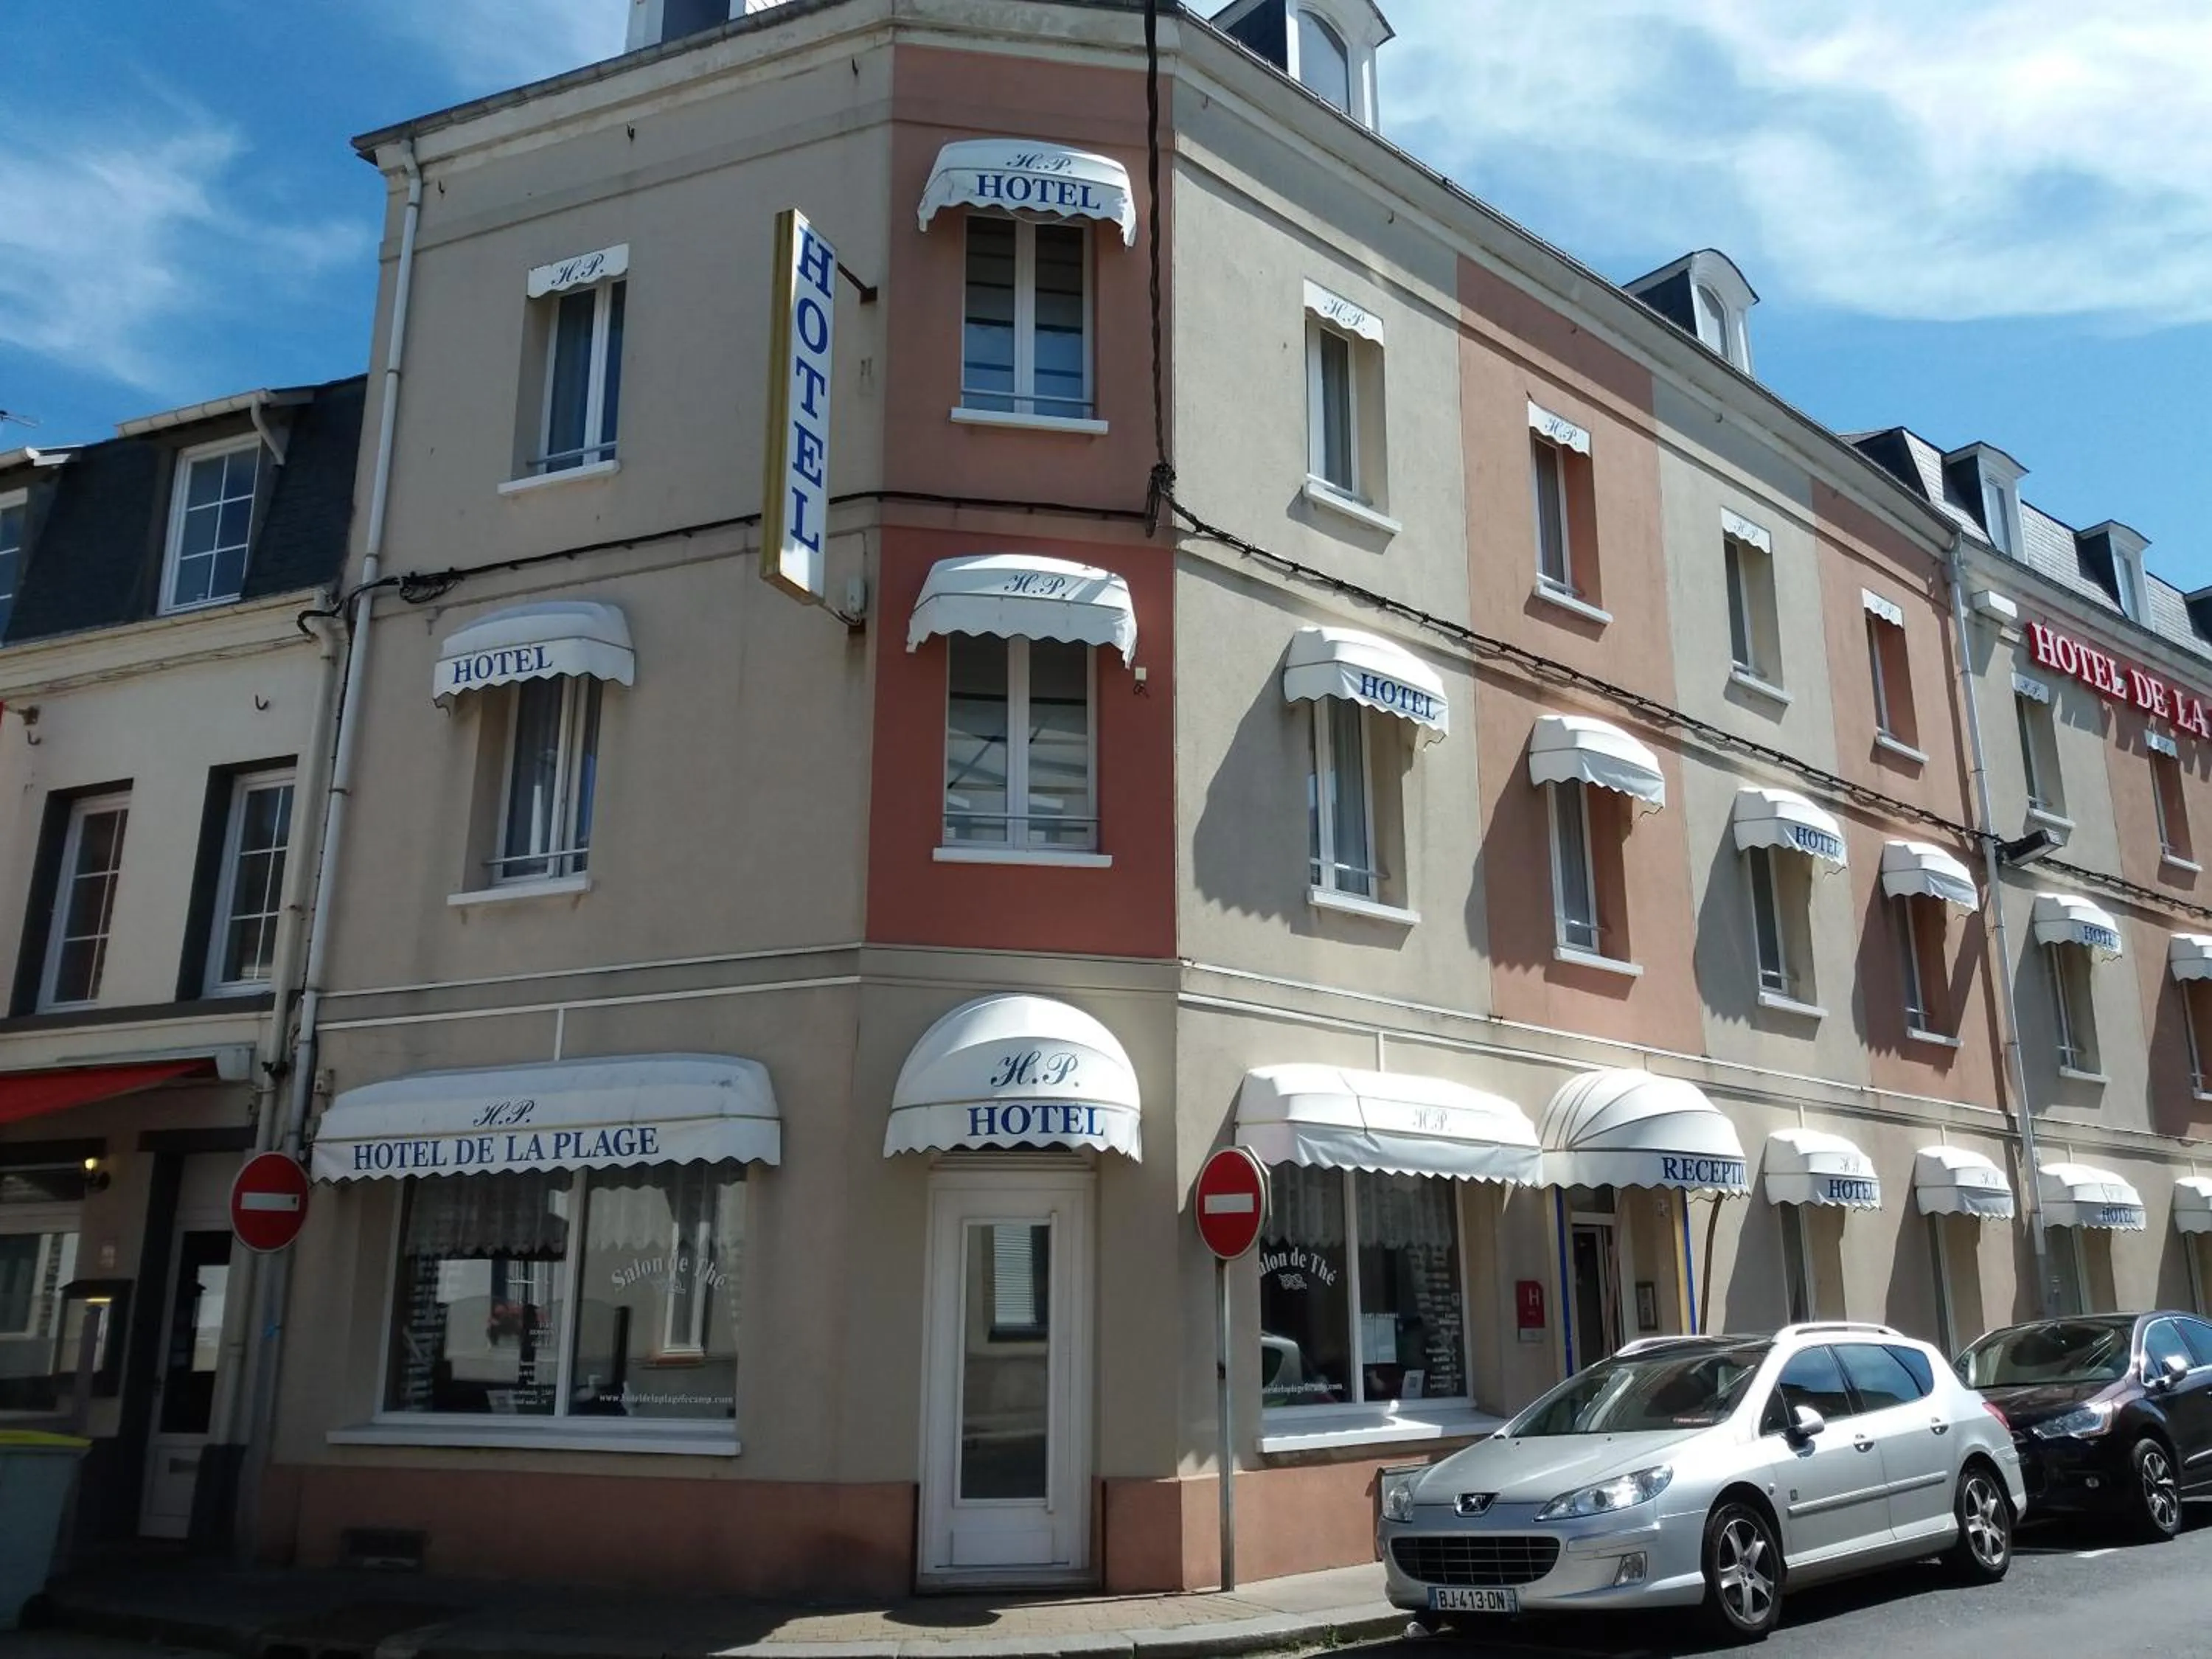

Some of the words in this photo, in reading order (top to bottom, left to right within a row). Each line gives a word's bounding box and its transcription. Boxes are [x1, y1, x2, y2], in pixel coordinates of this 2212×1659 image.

[975, 174, 1101, 209] HOTEL
[790, 225, 833, 553] HOTEL
[453, 645, 554, 684] HOTEL
[2029, 622, 2127, 700] HOTEL
[2129, 668, 2168, 718] DE
[2172, 689, 2211, 739] LA
[1360, 672, 1436, 720] HOTEL
[1795, 826, 1840, 858] HOTEL
[967, 1105, 1104, 1136] HOTEL
[353, 1140, 448, 1170] HOTEL
[455, 1136, 495, 1165] DE
[506, 1133, 546, 1162] LA
[552, 1127, 658, 1161] PLAGE
[1661, 1156, 1745, 1185] RECEPTI
[1828, 1179, 1877, 1201] HOTEL
[2101, 1207, 2135, 1223] HOTEL
[611, 1257, 664, 1289] Salon
[668, 1252, 689, 1273] de
[1259, 1252, 1287, 1277] alon
[1290, 1246, 1307, 1268] de
[1310, 1252, 1338, 1287] Thé
[1528, 1287, 1540, 1307] H
